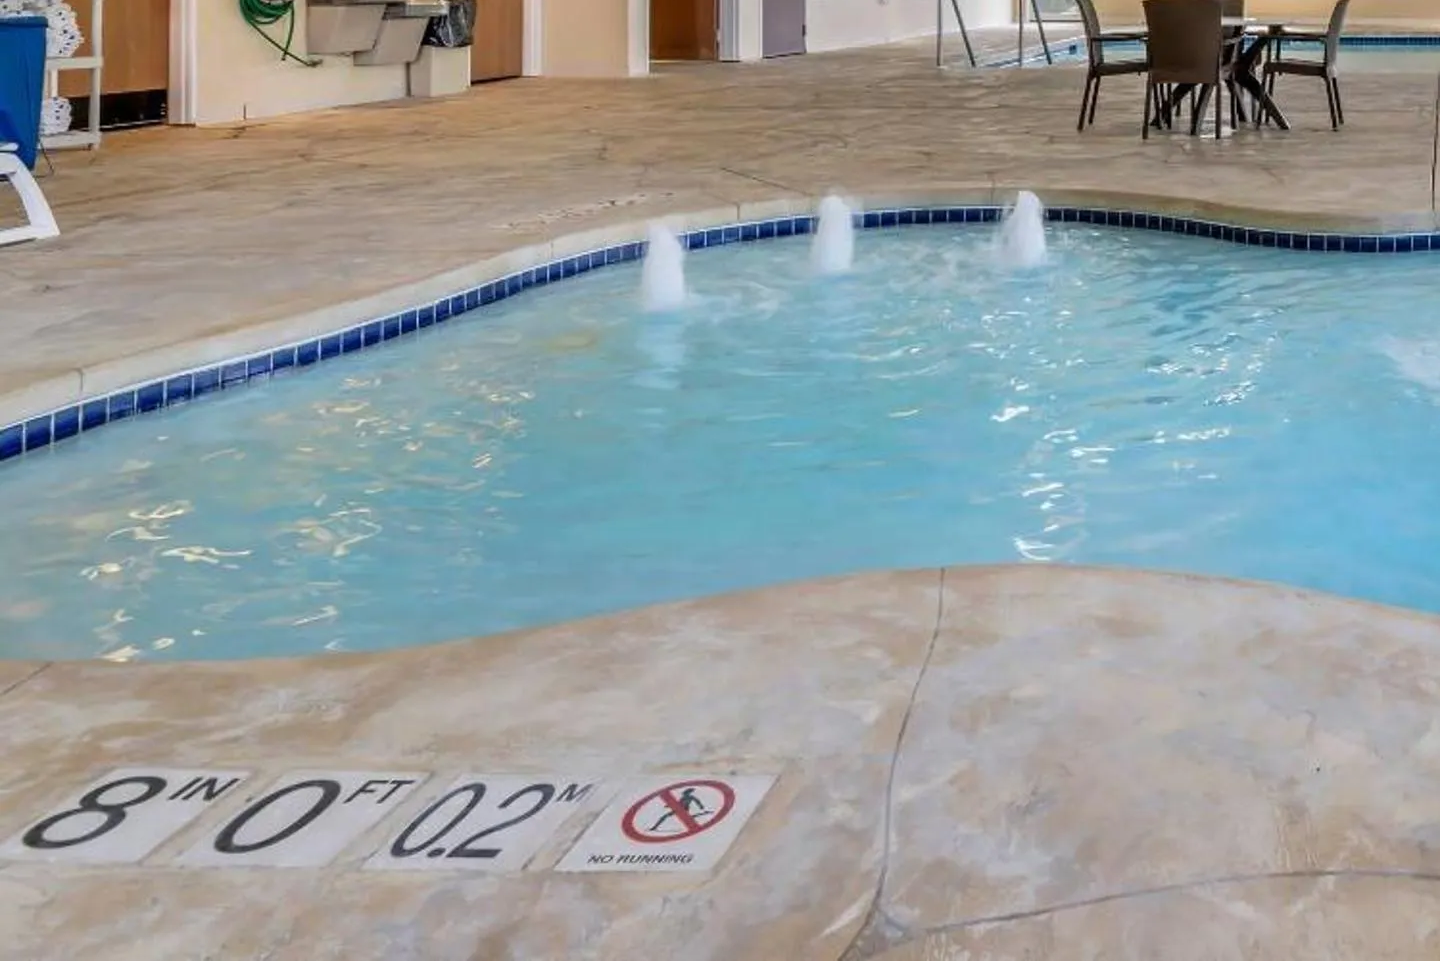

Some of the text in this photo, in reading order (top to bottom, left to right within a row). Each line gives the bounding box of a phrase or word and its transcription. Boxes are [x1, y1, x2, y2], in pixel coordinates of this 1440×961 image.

[22, 775, 594, 859] 8 IN 0 FT 0.2 M
[587, 854, 694, 864] NO RUNNING
